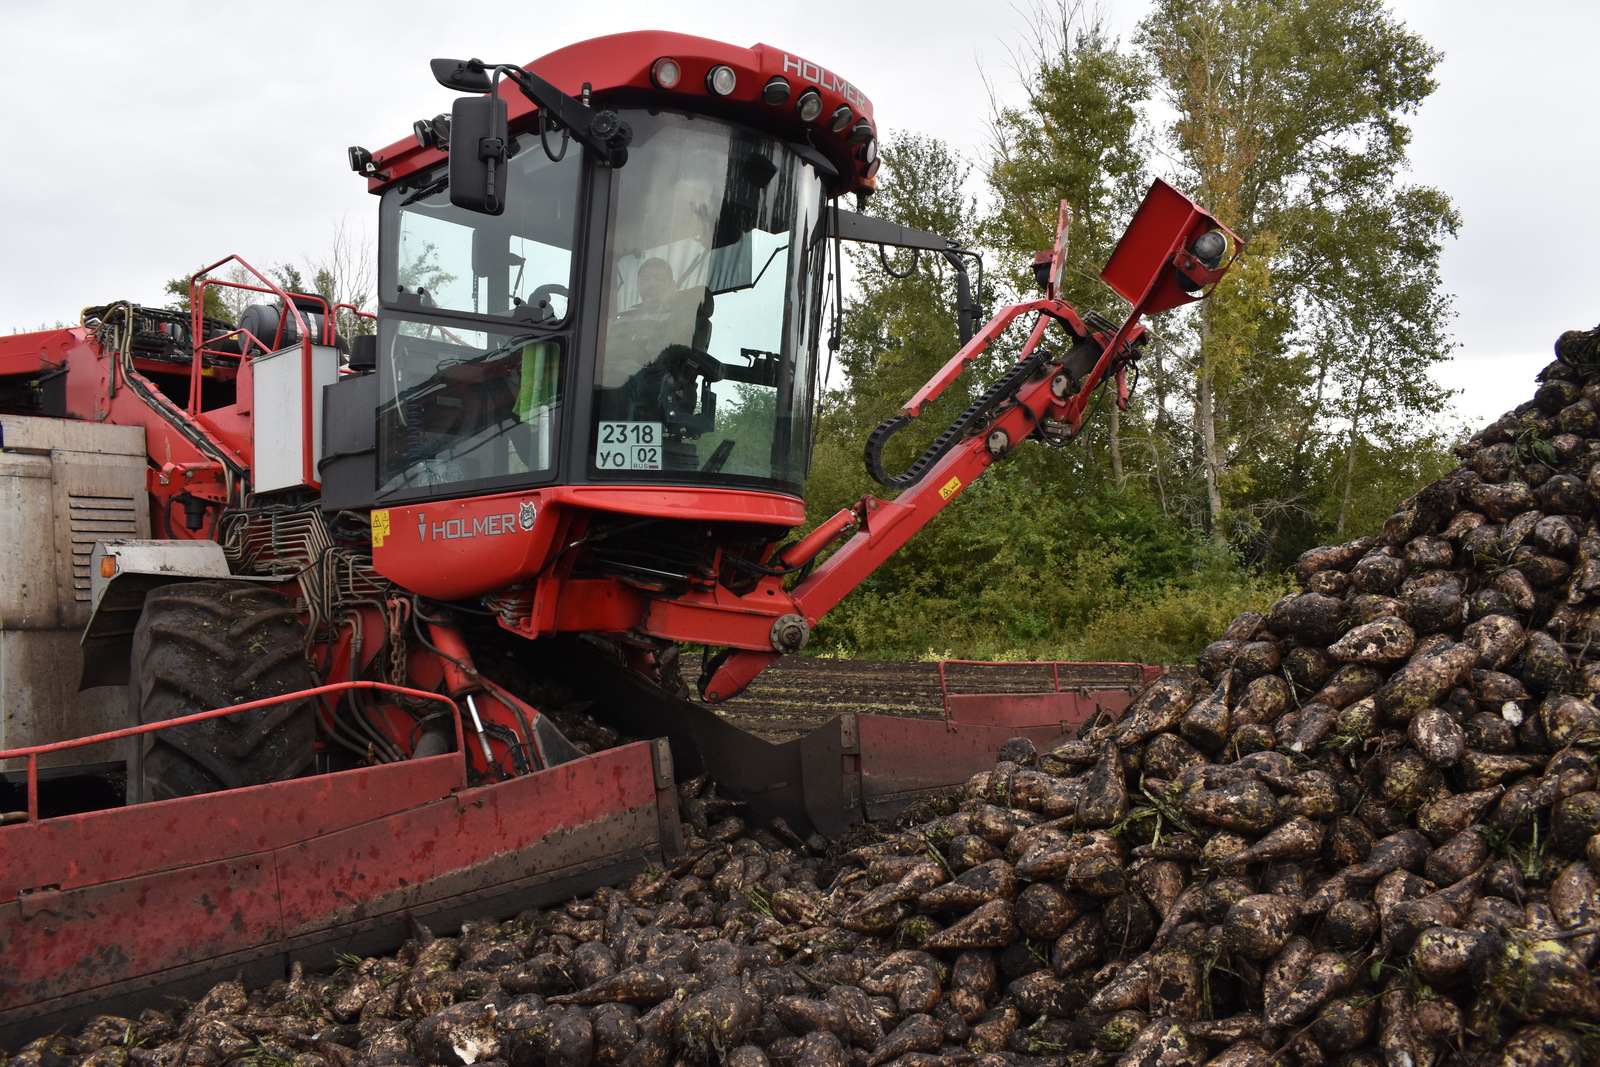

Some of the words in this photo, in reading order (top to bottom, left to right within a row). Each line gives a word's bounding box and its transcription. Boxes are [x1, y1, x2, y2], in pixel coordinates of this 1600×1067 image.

[783, 53, 865, 111] HOLMER
[602, 424, 654, 444] 2318
[637, 448, 657, 462] 02
[432, 513, 516, 540] HOLMER
